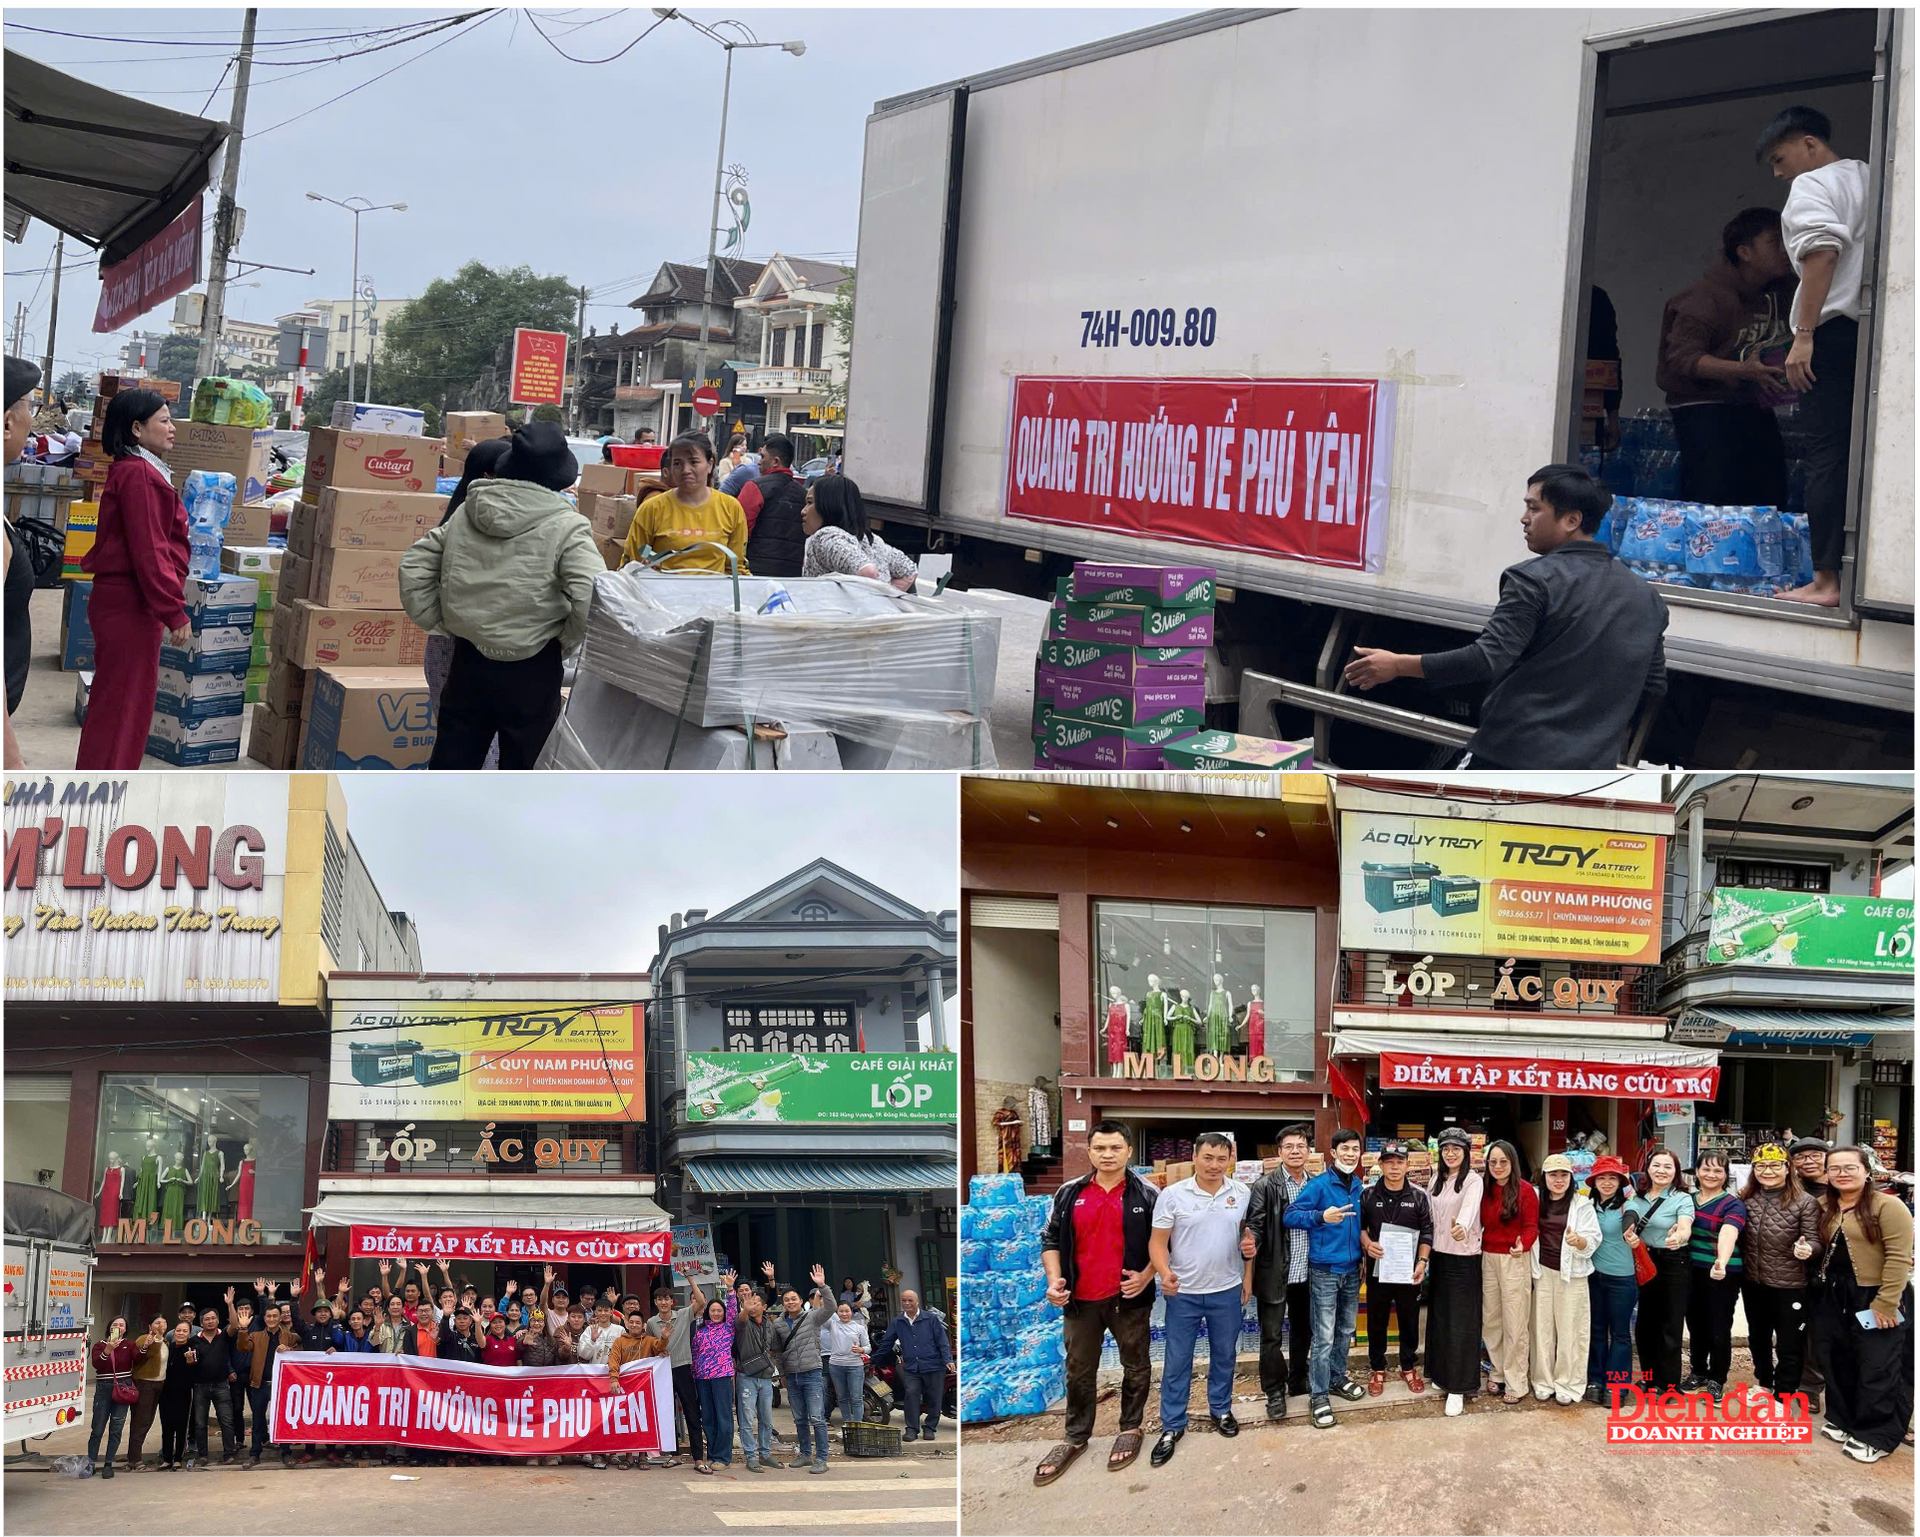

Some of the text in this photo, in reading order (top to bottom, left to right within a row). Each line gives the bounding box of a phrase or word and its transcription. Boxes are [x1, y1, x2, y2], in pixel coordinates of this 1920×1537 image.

[1081, 306, 1217, 348] 74H-009.80
[190, 428, 227, 443] MIKA
[367, 458, 412, 472] Custard
[1016, 392, 1361, 526] QUẢNG TRỊ HƯỚNG VỀ PHÚ YÊN
[354, 637, 386, 645] GOLD
[60, 781, 128, 805] MAY
[1394, 833, 1437, 846] QUY
[1438, 836, 1483, 850] TROY
[1609, 841, 1646, 849] PLATINUM
[1500, 841, 1599, 869] TROY
[1592, 863, 1640, 872] BATTERY
[1498, 885, 1653, 910] ẮC QUY NAM PHƯƠNG
[1498, 909, 1544, 920] 0983.66.55.77
[1864, 904, 1894, 918] CAFÉ
[88, 906, 159, 932] Veston
[164, 906, 213, 932] Thời
[217, 906, 281, 940] Trang
[1874, 921, 1914, 958] LỐ
[129, 974, 145, 989] HÀ
[1381, 955, 1625, 1008] LỐP ẮC QUY
[379, 1016, 419, 1027] QUY
[479, 1017, 576, 1036] TROY
[500, 1059, 530, 1071] QUY
[533, 1059, 567, 1070] NAM
[571, 1058, 634, 1070] PHƯƠNG
[850, 1057, 954, 1071] CAFÉ GIẢI KHÁT
[478, 1077, 523, 1085] 0983.66.55.77
[532, 1076, 557, 1085] CHUYÊN
[557, 1077, 573, 1085] KINH
[573, 1077, 597, 1085] DOANH
[621, 1077, 634, 1086] QUY
[1393, 1056, 1451, 1085] ĐIỂM
[1456, 1063, 1501, 1090] TẬP
[1507, 1062, 1551, 1088] KẾT
[1557, 1067, 1618, 1091] HÀNG
[1624, 1072, 1667, 1094] CỨU
[871, 1073, 933, 1108] LỐP
[1553, 1120, 1565, 1130] 139
[365, 1122, 608, 1168] LỐP ẮC QUY
[362, 1226, 413, 1253] ĐIỂM
[418, 1233, 457, 1257] TẬP
[464, 1231, 502, 1255] KẾT
[506, 1234, 570, 1256] HÀNG
[575, 1236, 618, 1259] CỨU
[50, 1317, 74, 1328] 353.30
[285, 1372, 649, 1439] QUẢNG TRỊ HƯỚNG VỀ PHÚ YÊN
